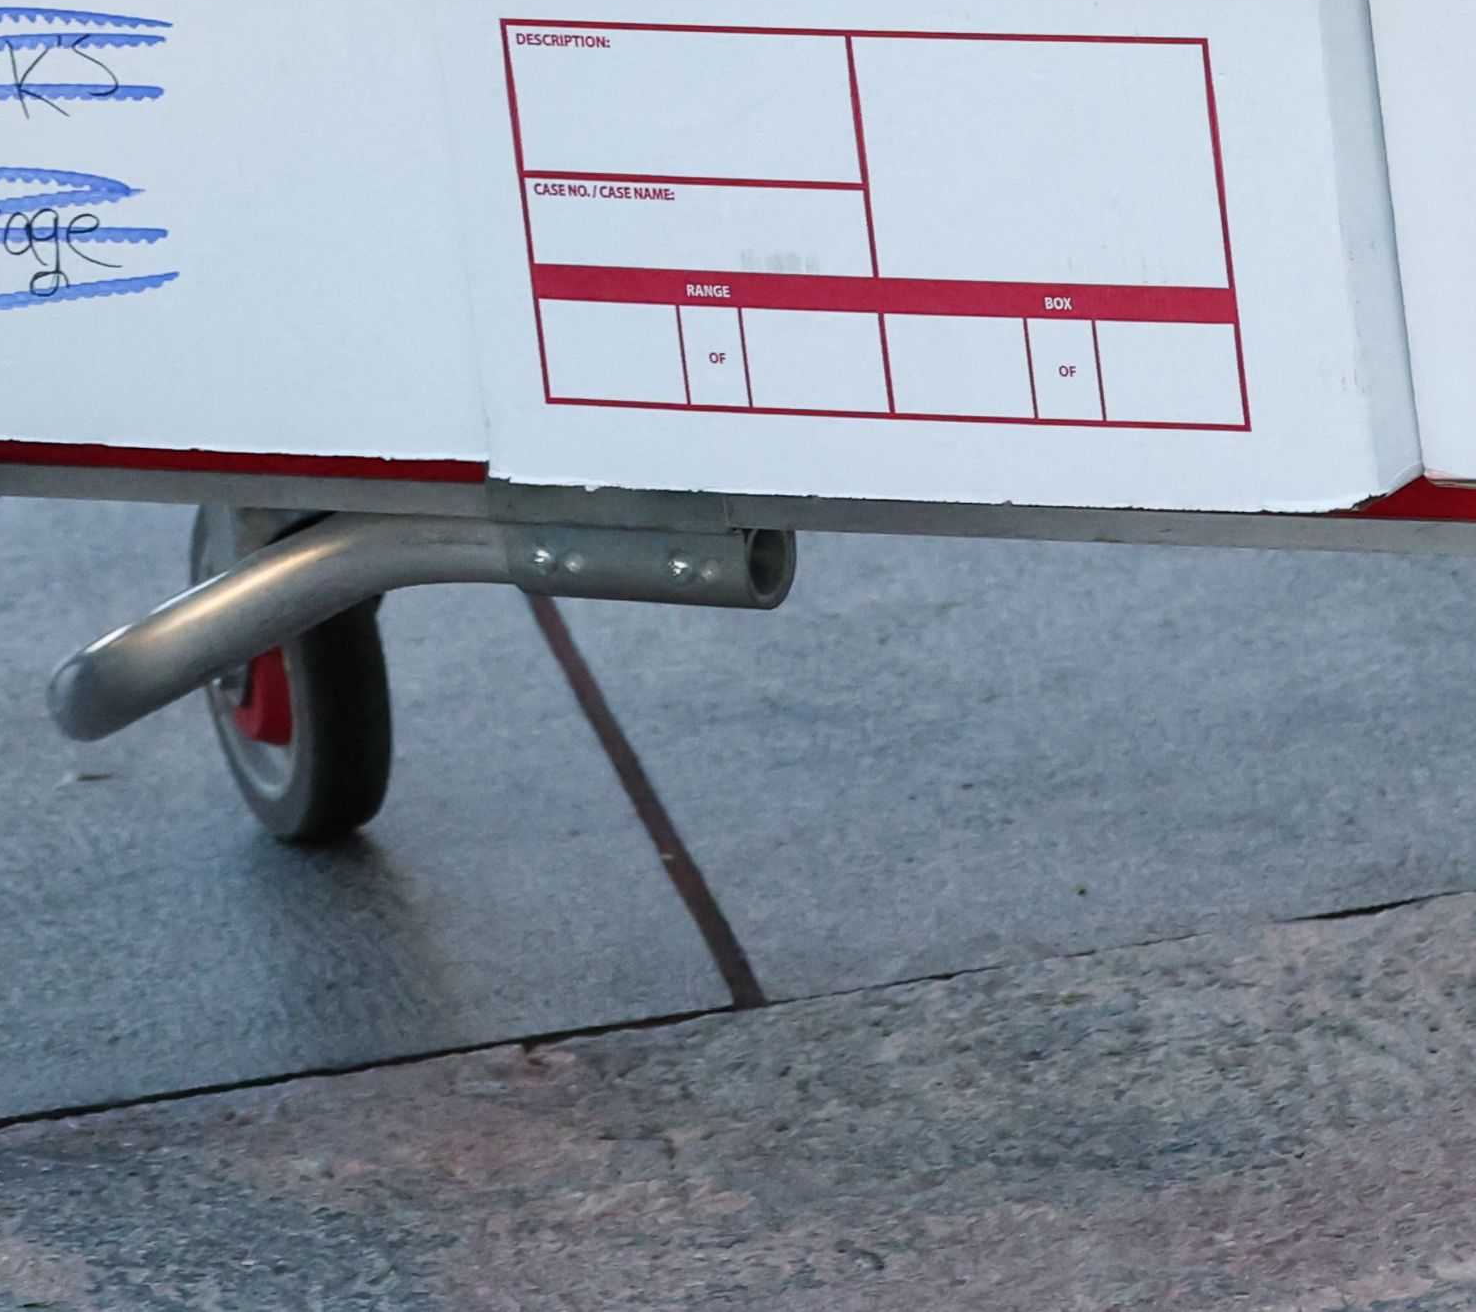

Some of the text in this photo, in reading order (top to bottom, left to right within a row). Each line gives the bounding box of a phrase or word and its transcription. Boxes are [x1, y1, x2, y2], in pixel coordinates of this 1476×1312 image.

[515, 32, 611, 49] DESCRIPTION:
[533, 183, 565, 196] CASE
[568, 184, 590, 197] NO.
[599, 186, 632, 199] CASE
[634, 187, 675, 201] NAME:
[686, 284, 731, 298] RANGE
[1044, 296, 1073, 310] BOX
[708, 352, 726, 364] OF
[1058, 365, 1077, 378] OF
